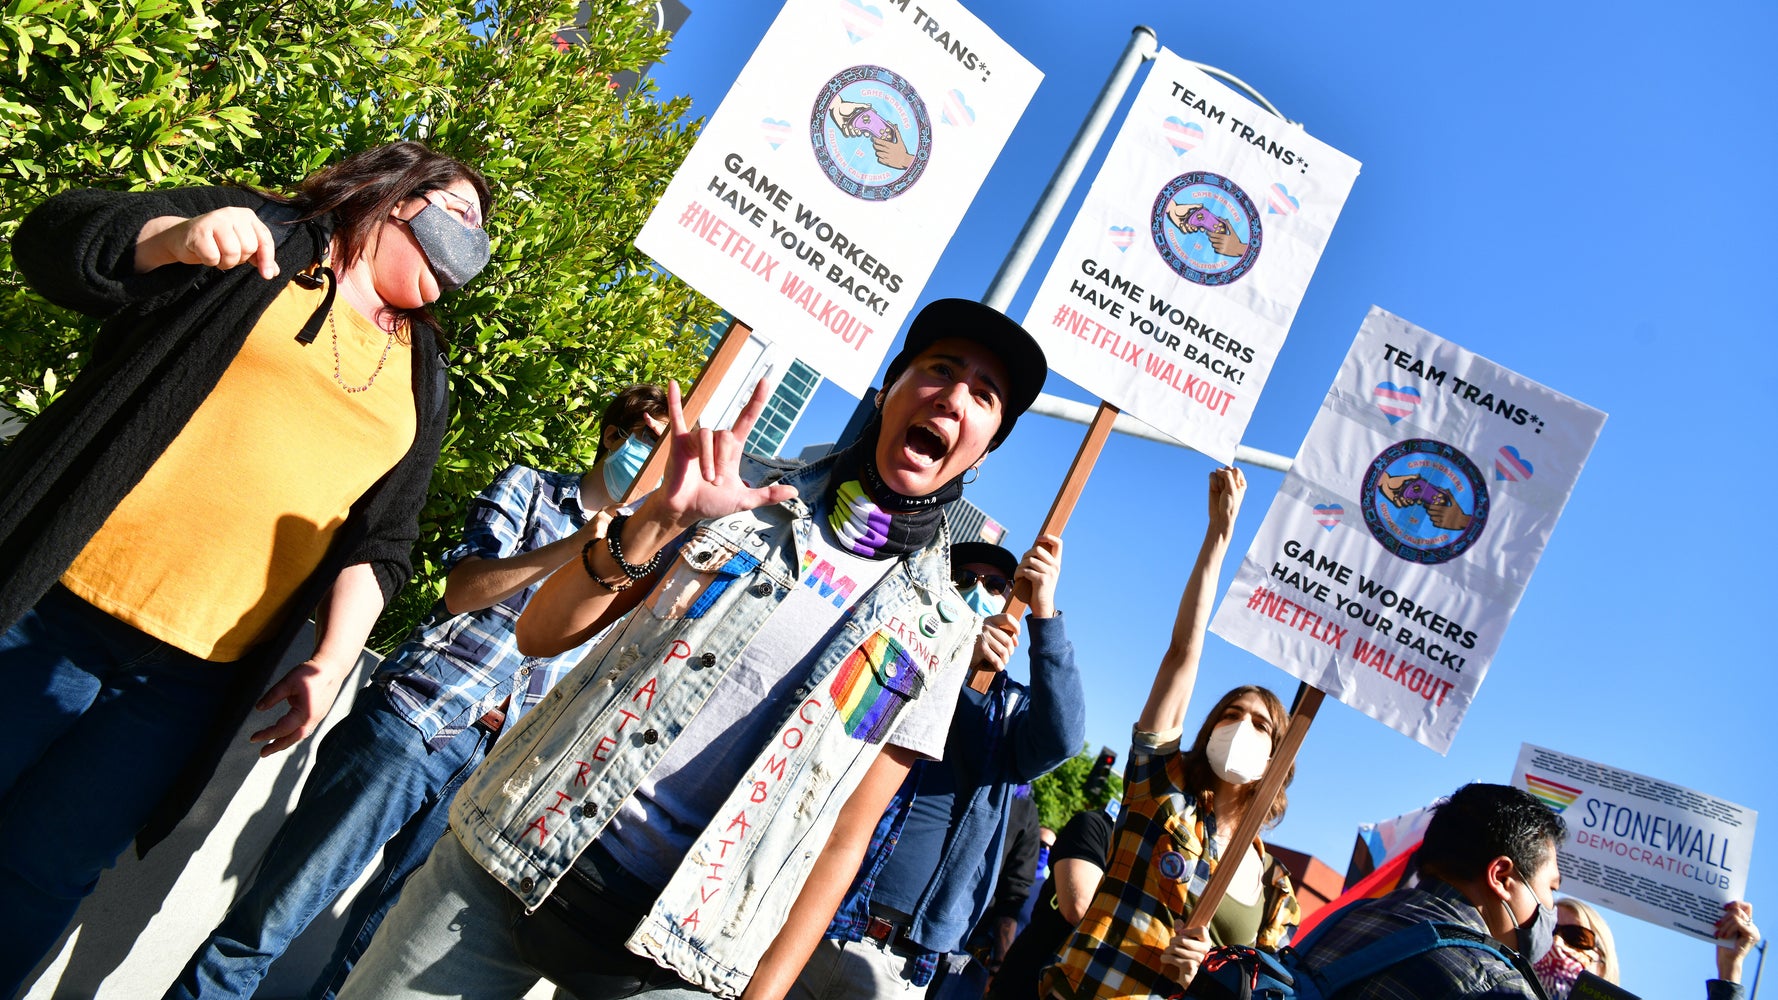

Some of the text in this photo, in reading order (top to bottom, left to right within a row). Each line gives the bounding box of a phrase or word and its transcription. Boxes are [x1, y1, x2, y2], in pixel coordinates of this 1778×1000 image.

[862, 89, 883, 98] GAME
[1171, 81, 1226, 125] TEAM
[678, 201, 874, 351] #NETFLIX WALKOUT
[707, 176, 890, 317] HAVE YOUR BACK!
[724, 153, 903, 294] GAME WORKERS
[1051, 304, 1235, 416] #NETFLIX WALKOUT
[1070, 280, 1245, 385] HAVE YOUR BACK!
[1081, 259, 1255, 364] GAME WORKERS
[1382, 343, 1447, 387] TEAM
[1247, 585, 1454, 708] #NETFLIX WALKOUT
[1270, 562, 1466, 673] HAVE YOUR BACK!
[1283, 540, 1478, 649] GAME WORKERS
[679, 699, 821, 931] COMBATIVA
[1583, 798, 1732, 872] STONEWALL
